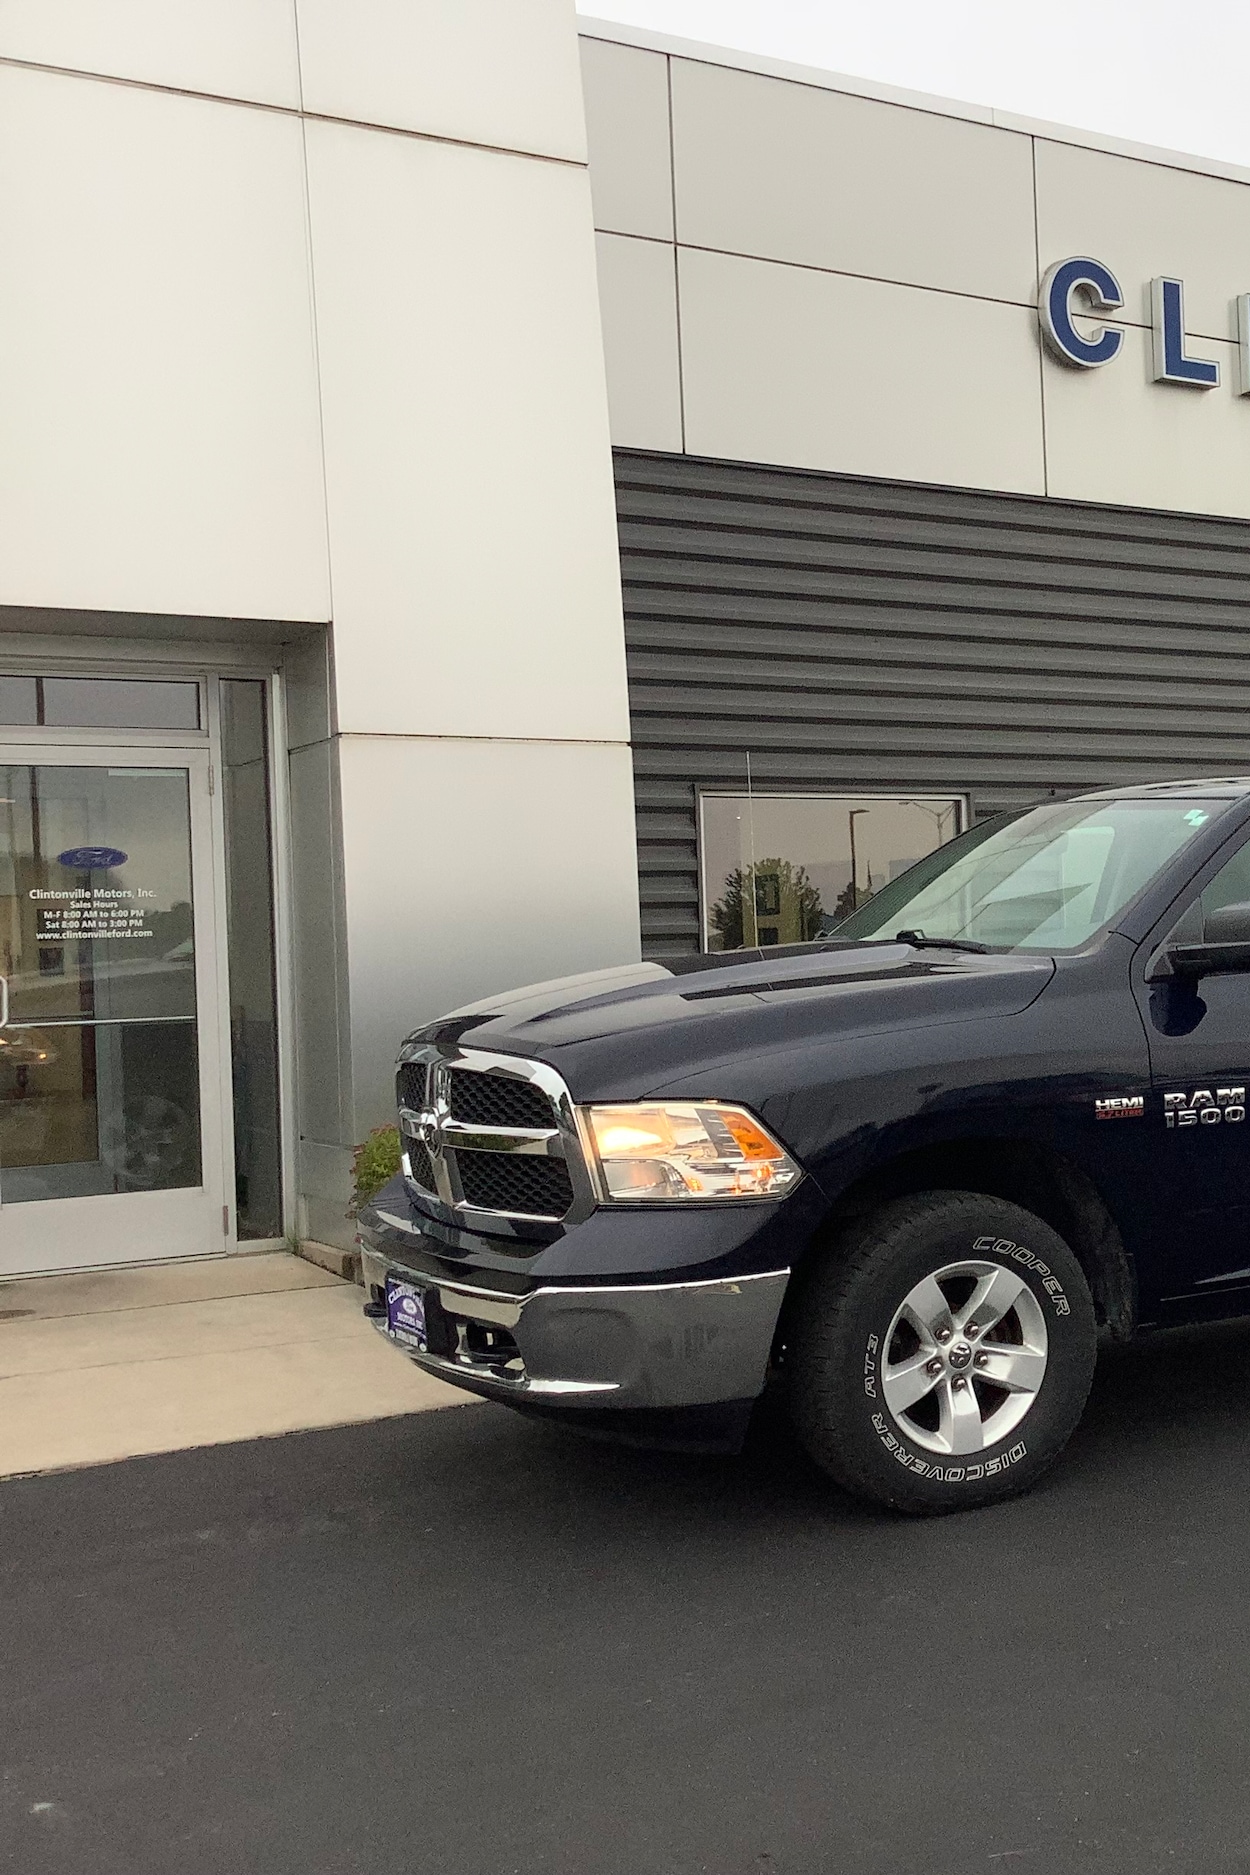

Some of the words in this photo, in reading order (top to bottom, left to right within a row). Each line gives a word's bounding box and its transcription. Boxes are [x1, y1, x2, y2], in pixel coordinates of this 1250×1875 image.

[29, 889, 91, 900] Clintonville
[93, 888, 135, 900] Motors,
[138, 888, 157, 898] Inc.
[70, 900, 91, 909] Sales
[93, 900, 118, 909] Hours
[43, 911, 61, 919] M-F
[63, 910, 81, 919] 8:00
[83, 910, 98, 919] AM
[99, 910, 109, 918] to
[110, 910, 129, 918] 6:00
[45, 921, 60, 929] Sat
[61, 920, 80, 929] 8:00
[81, 920, 96, 929] AM
[98, 920, 107, 928] to
[109, 920, 128, 928] 3:00
[36, 930, 153, 940] www.clintonvilleford.com
[1095, 1096, 1144, 1111] HEMI
[1164, 1087, 1246, 1110] RAM
[1164, 1106, 1246, 1129] 1500
[972, 1236, 1071, 1317] COOPER
[865, 1333, 879, 1398] AT3
[871, 1412, 1027, 1482] DISCOVERER
